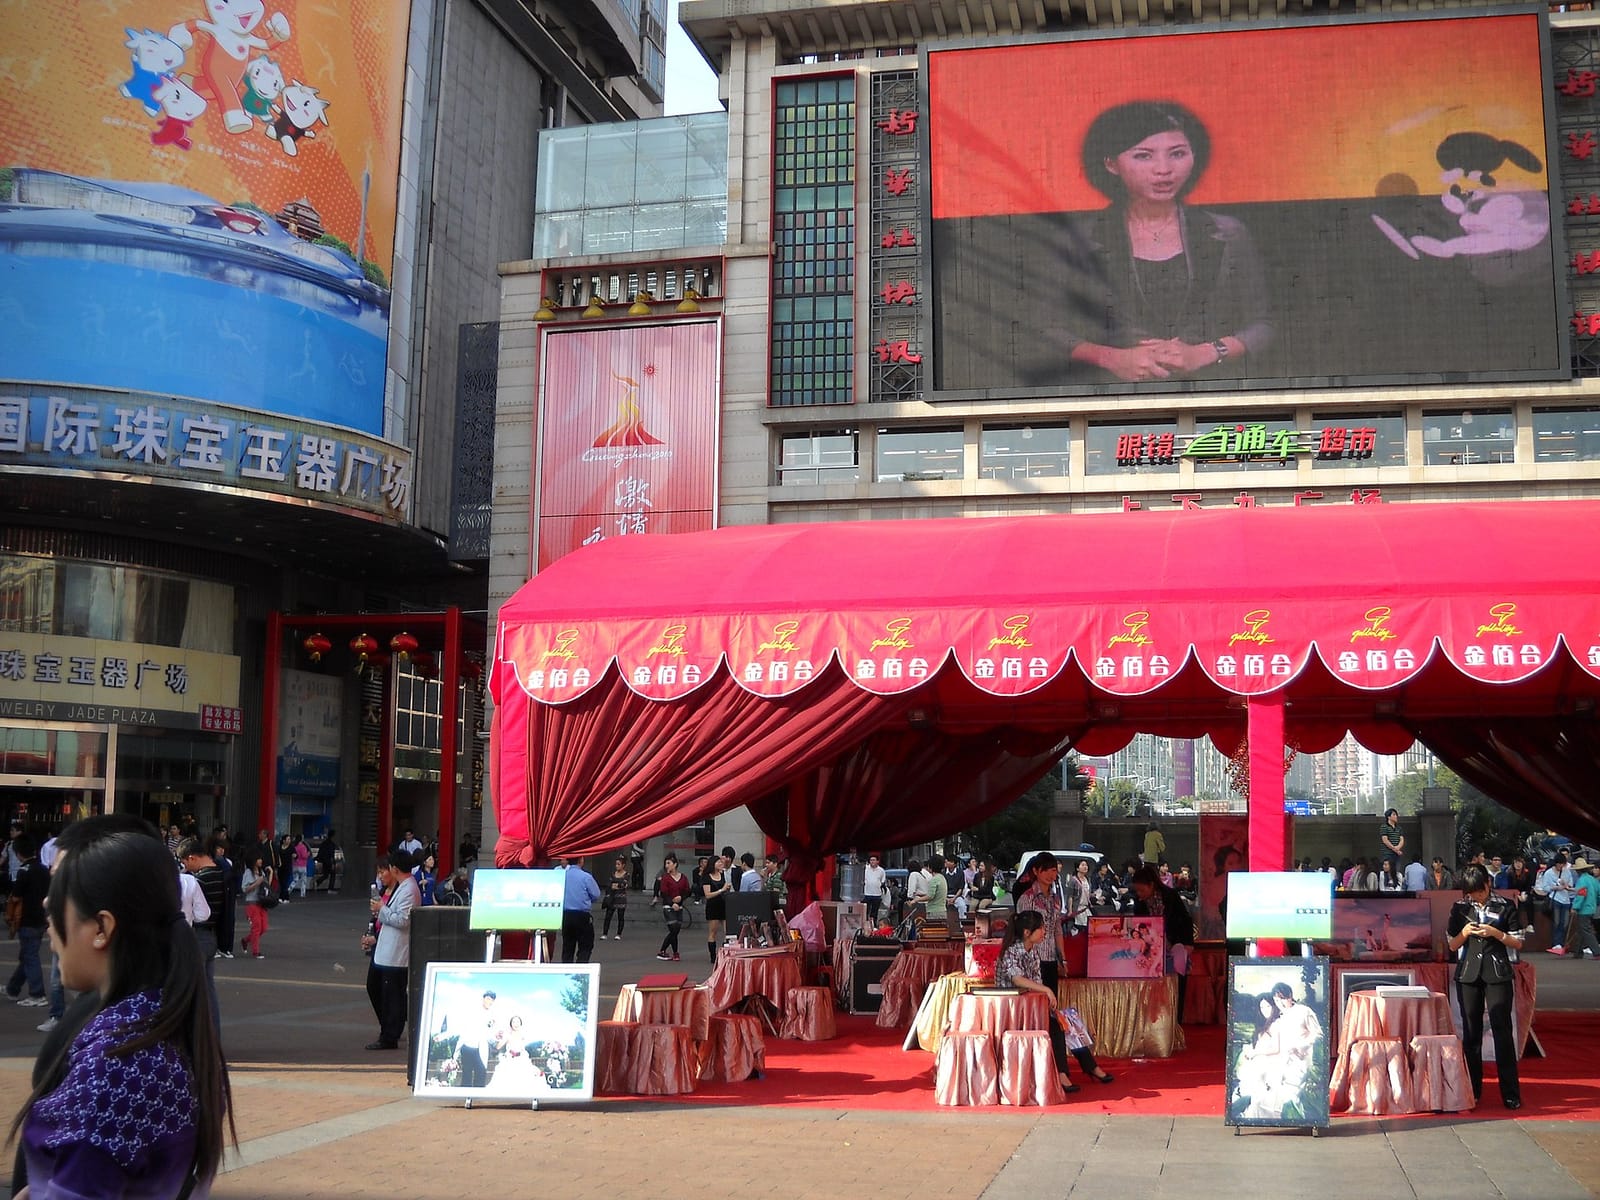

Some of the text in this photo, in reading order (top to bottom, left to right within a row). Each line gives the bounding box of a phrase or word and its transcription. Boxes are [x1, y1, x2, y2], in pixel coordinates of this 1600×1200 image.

[1116, 432, 1175, 460] 眼镜
[1318, 427, 1377, 454] 超市
[1095, 654, 1171, 679] 金佰合
[1215, 653, 1292, 677] 金佰合
[1337, 648, 1416, 673] 金佰合
[1463, 643, 1542, 667] 金佰合
[527, 667, 591, 690] 金佰合
[632, 664, 702, 686] 金佰合
[743, 660, 815, 683] 金佰合
[856, 657, 930, 680] 金佰合
[974, 656, 1049, 679] 金佰合
[67, 705, 106, 721] JADE
[112, 709, 157, 724] PLAZA
